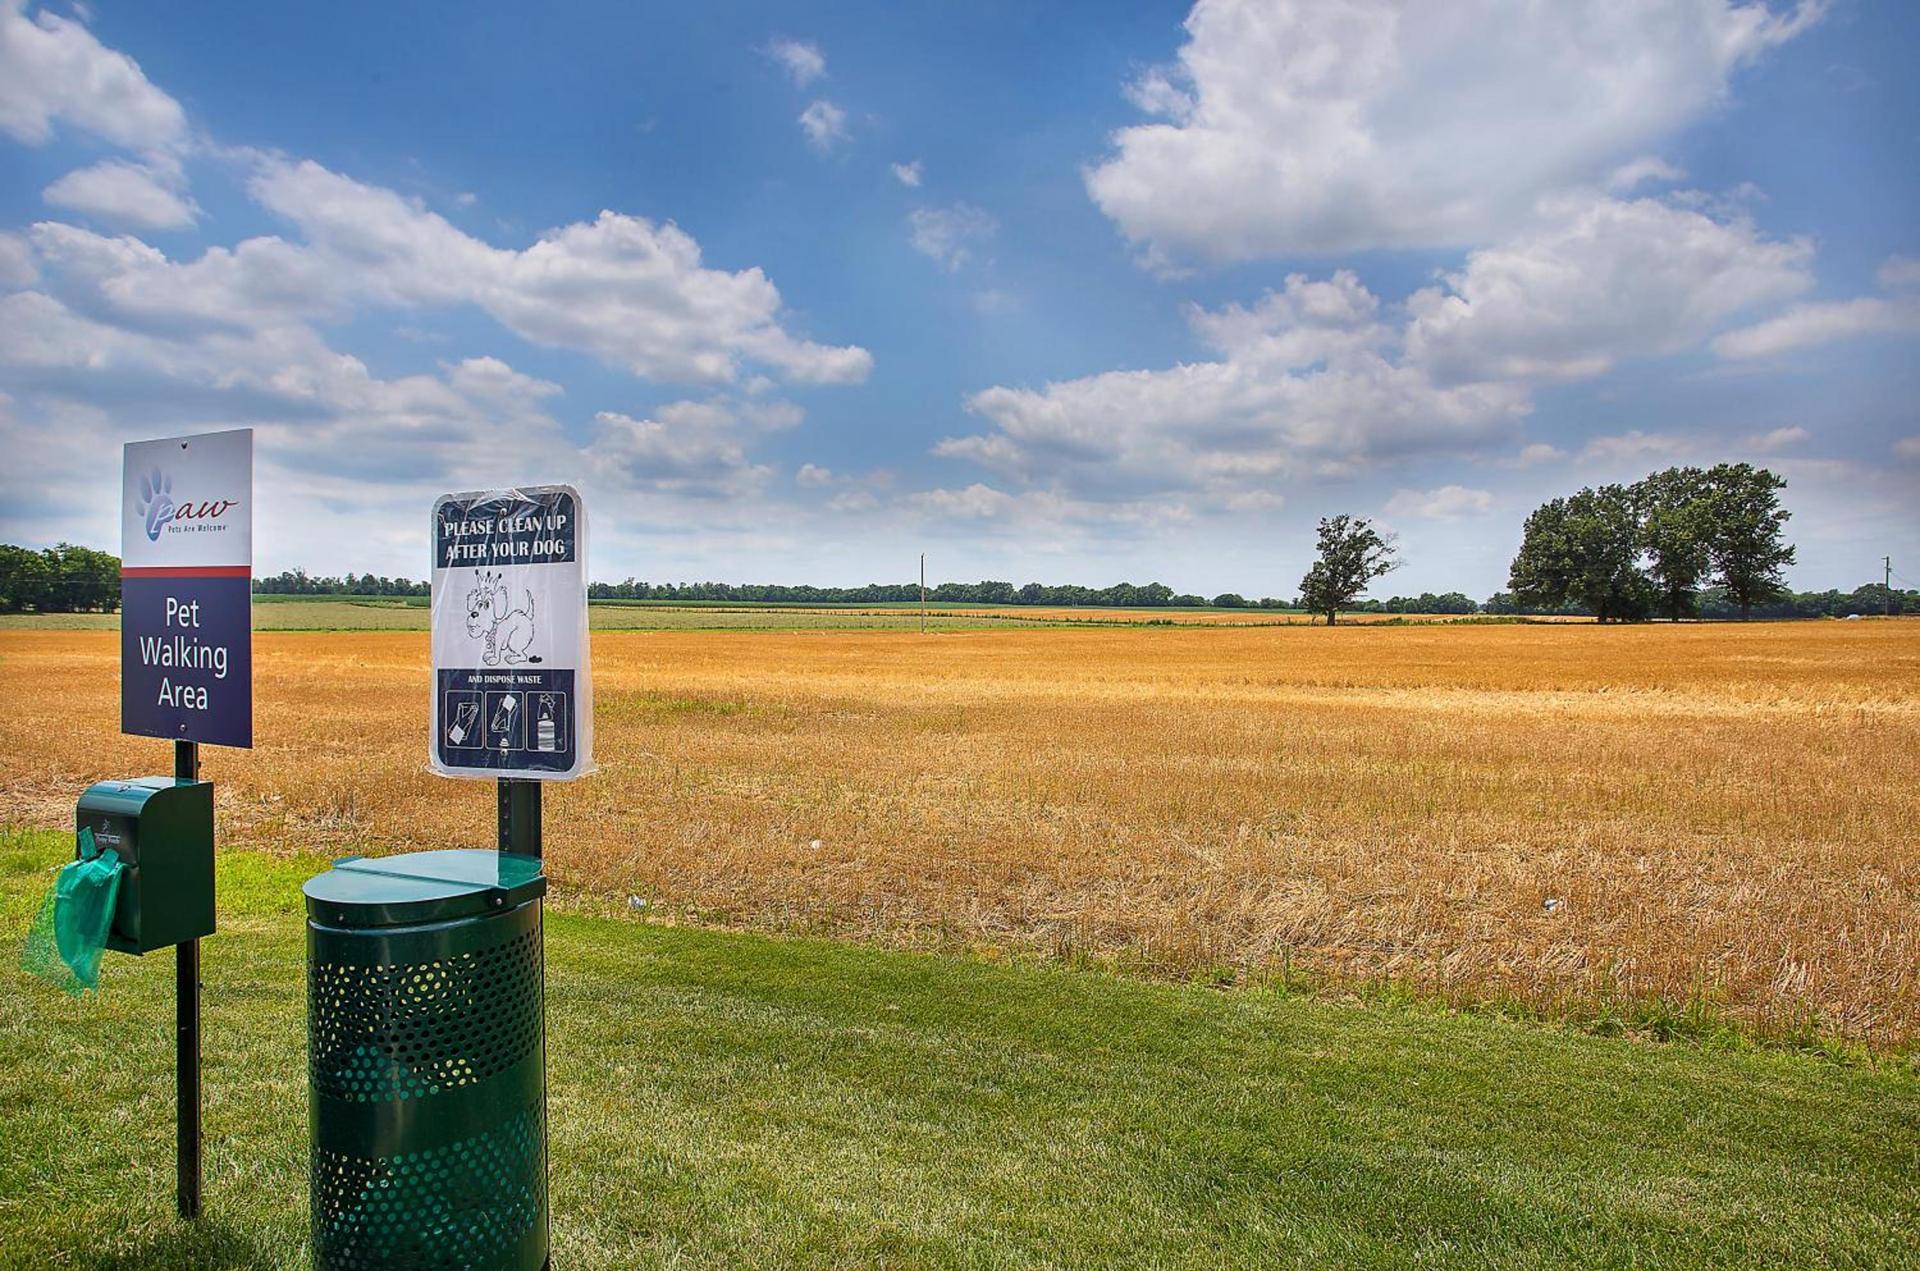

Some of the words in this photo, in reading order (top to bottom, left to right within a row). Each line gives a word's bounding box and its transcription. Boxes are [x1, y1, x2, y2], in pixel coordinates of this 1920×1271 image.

[198, 524, 227, 532] Welcome
[445, 520, 494, 537] PLEASE
[499, 517, 542, 533] CLEAN
[547, 515, 566, 530] UP
[446, 543, 487, 559] AFTER
[491, 541, 529, 557] YOUR
[534, 539, 565, 555] DOG
[166, 597, 200, 628] Pet
[139, 635, 228, 679] Walking
[468, 675, 483, 683] AND
[484, 675, 516, 684] DISPOSE
[517, 675, 542, 684] WASTE
[157, 677, 208, 710] Area
